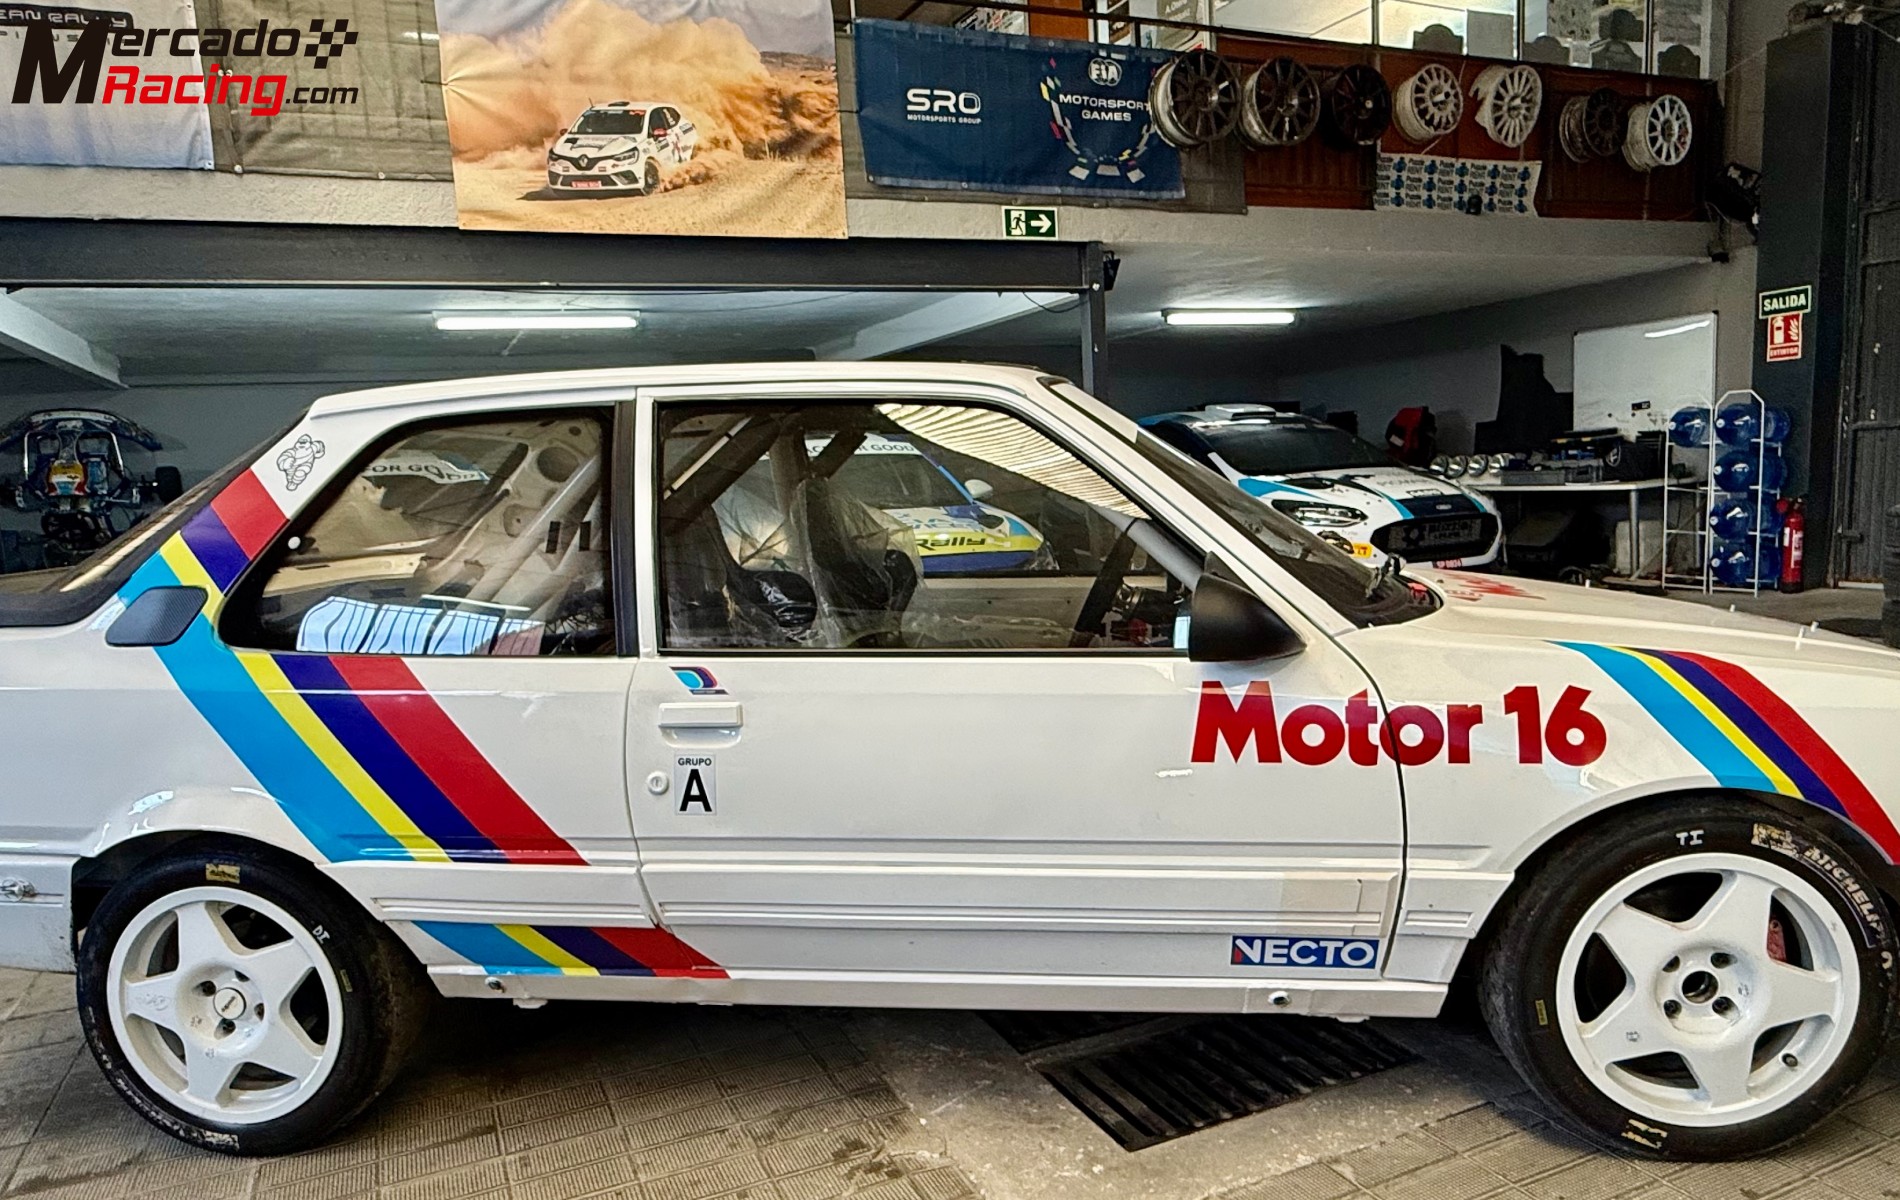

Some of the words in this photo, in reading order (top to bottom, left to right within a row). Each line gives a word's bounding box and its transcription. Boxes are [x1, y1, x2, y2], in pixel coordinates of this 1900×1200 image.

[48, 12, 127, 28] RALY
[1089, 62, 1120, 83] FIA
[907, 88, 981, 114] SRO
[1059, 94, 1150, 111] MOTORSPORT
[907, 114, 956, 123] MOTORSPORTS
[958, 117, 981, 125] GROUP
[1081, 110, 1132, 121] GAMES
[1763, 294, 1806, 311] SALIDA
[871, 444, 914, 452] GOOD
[915, 537, 986, 551] Rally
[1190, 680, 1483, 767] Motor
[1503, 685, 1607, 767] 16
[678, 758, 712, 766] GRUPO
[679, 769, 712, 812] A
[1234, 938, 1375, 967] NECTO
